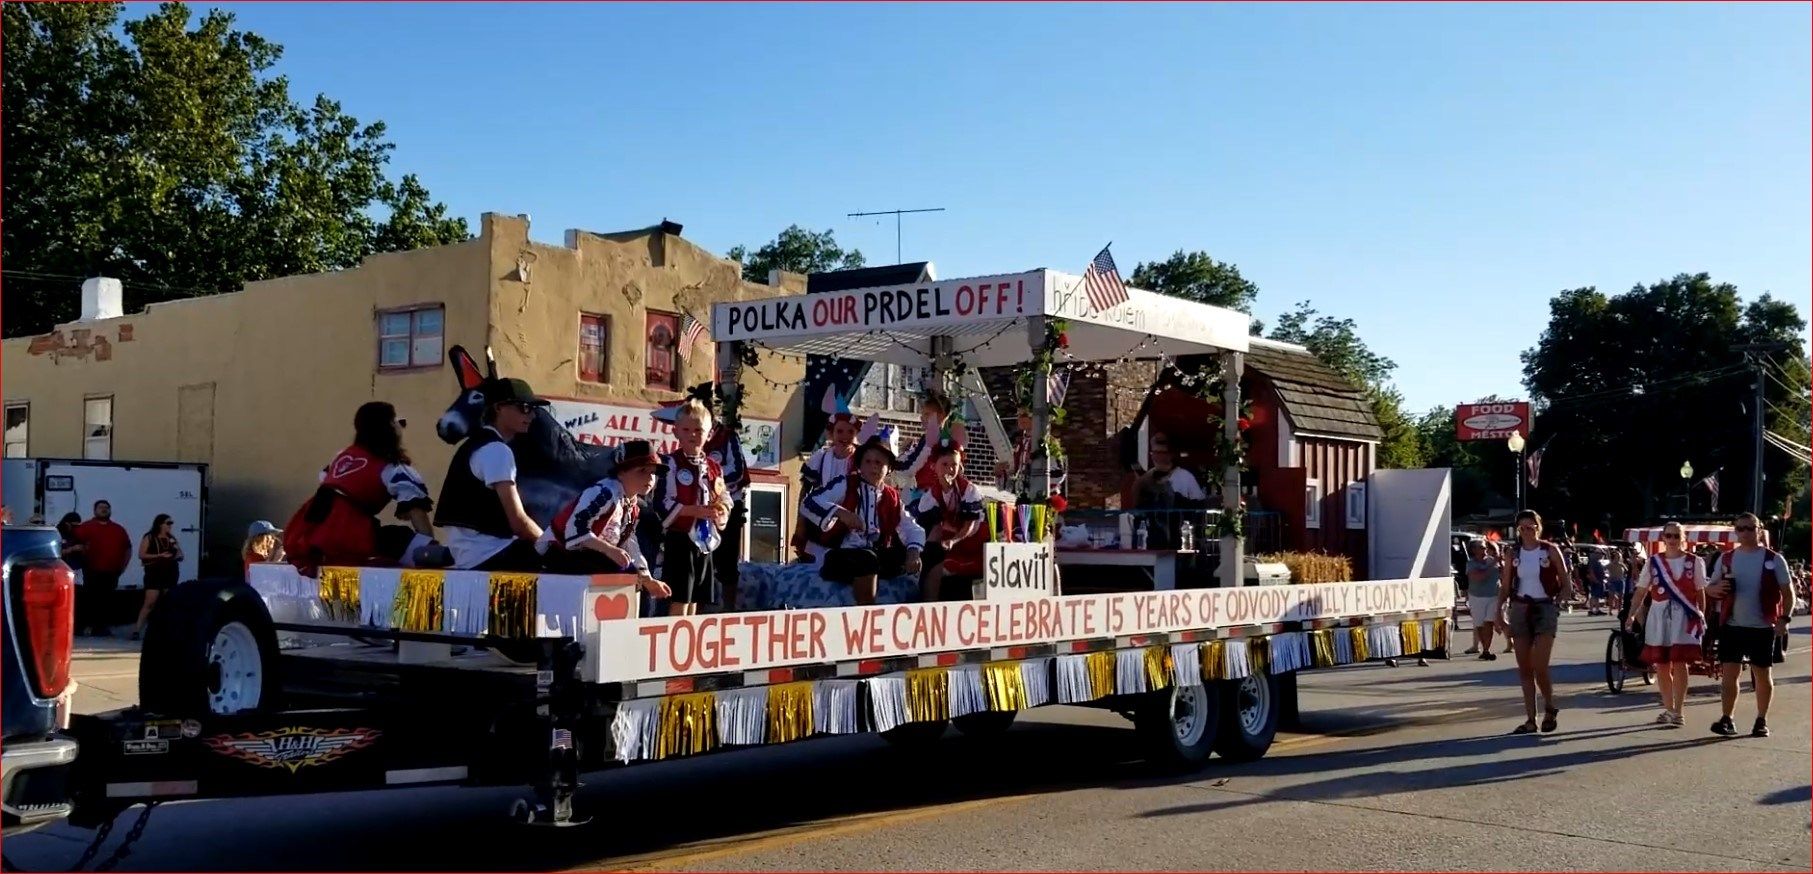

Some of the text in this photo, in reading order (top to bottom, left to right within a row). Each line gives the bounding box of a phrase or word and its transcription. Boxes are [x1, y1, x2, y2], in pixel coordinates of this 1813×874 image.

[728, 279, 1024, 335] POLKA OUR PRDEL OFF!
[1471, 405, 1515, 415] FOOD
[564, 412, 600, 429] WILL
[605, 415, 642, 432] ALL
[989, 546, 1049, 590] slavit
[639, 582, 1414, 672] TOGETHER WE CAN CELEBRATE 15 YEARS OF ODVODY FAMILY FLOATS!
[279, 736, 314, 750] H&H
